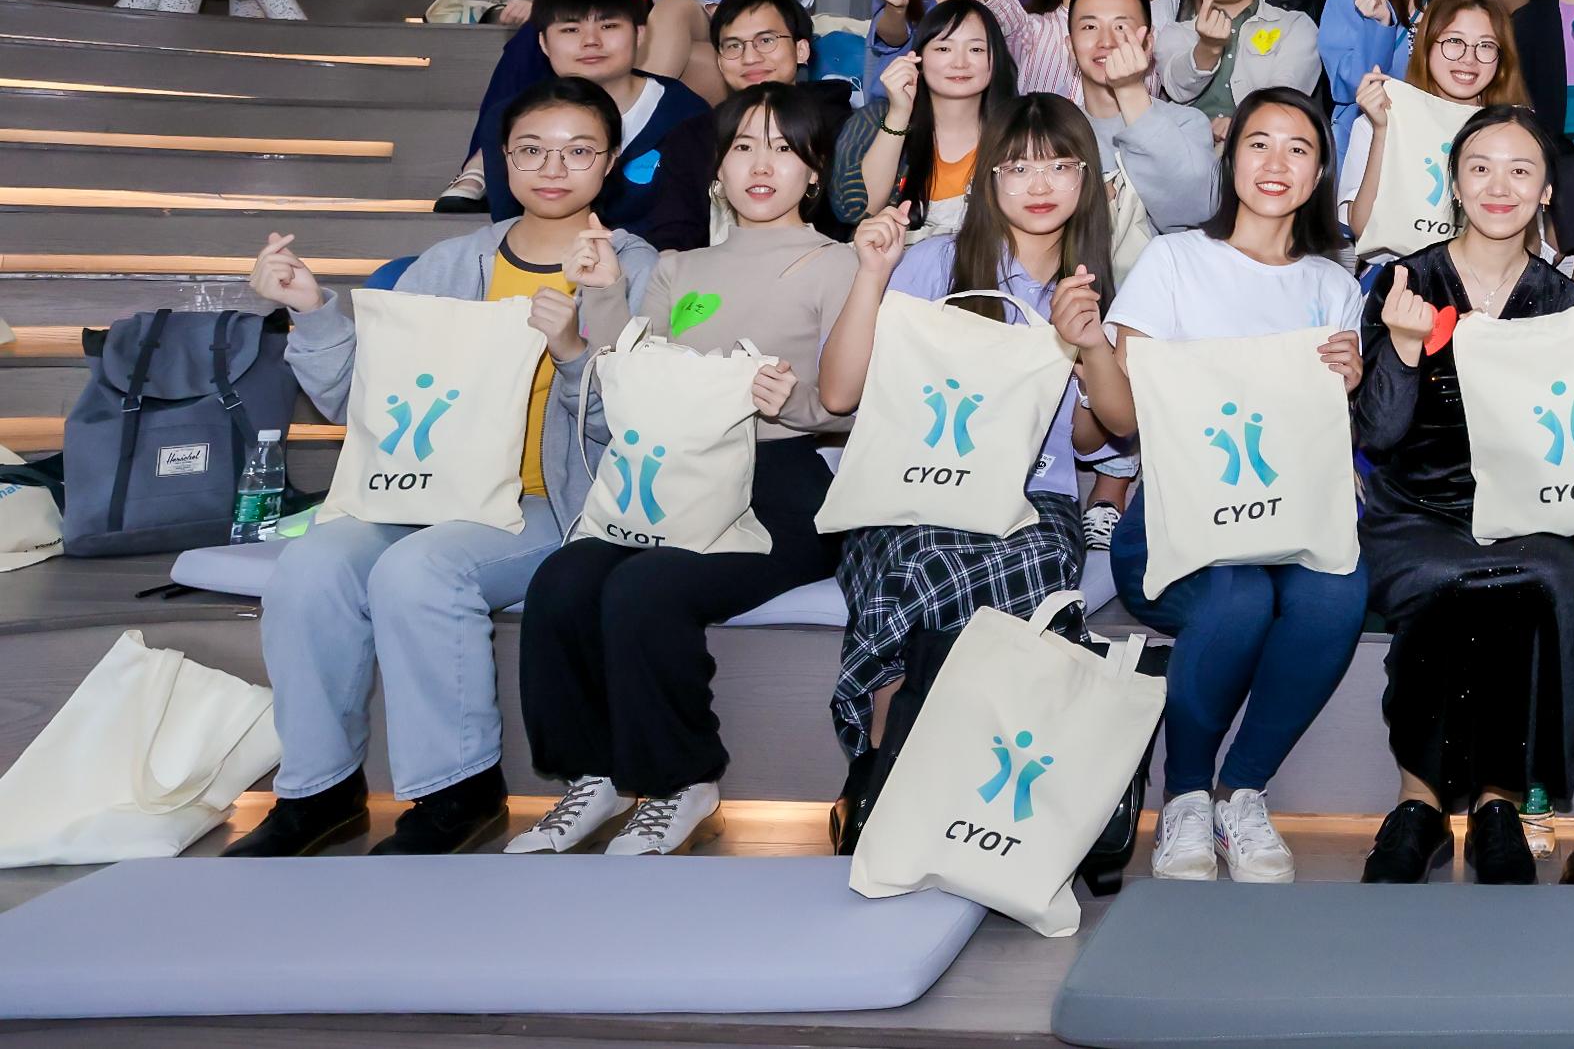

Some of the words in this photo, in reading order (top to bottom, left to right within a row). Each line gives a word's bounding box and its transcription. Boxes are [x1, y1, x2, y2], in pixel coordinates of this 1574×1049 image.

[1414, 218, 1463, 237] CYOT
[368, 472, 433, 491] CYOT
[903, 465, 972, 487] CYOT
[1213, 496, 1282, 526] CYOT
[606, 523, 666, 548] CYOT
[945, 819, 1022, 856] CYOT
